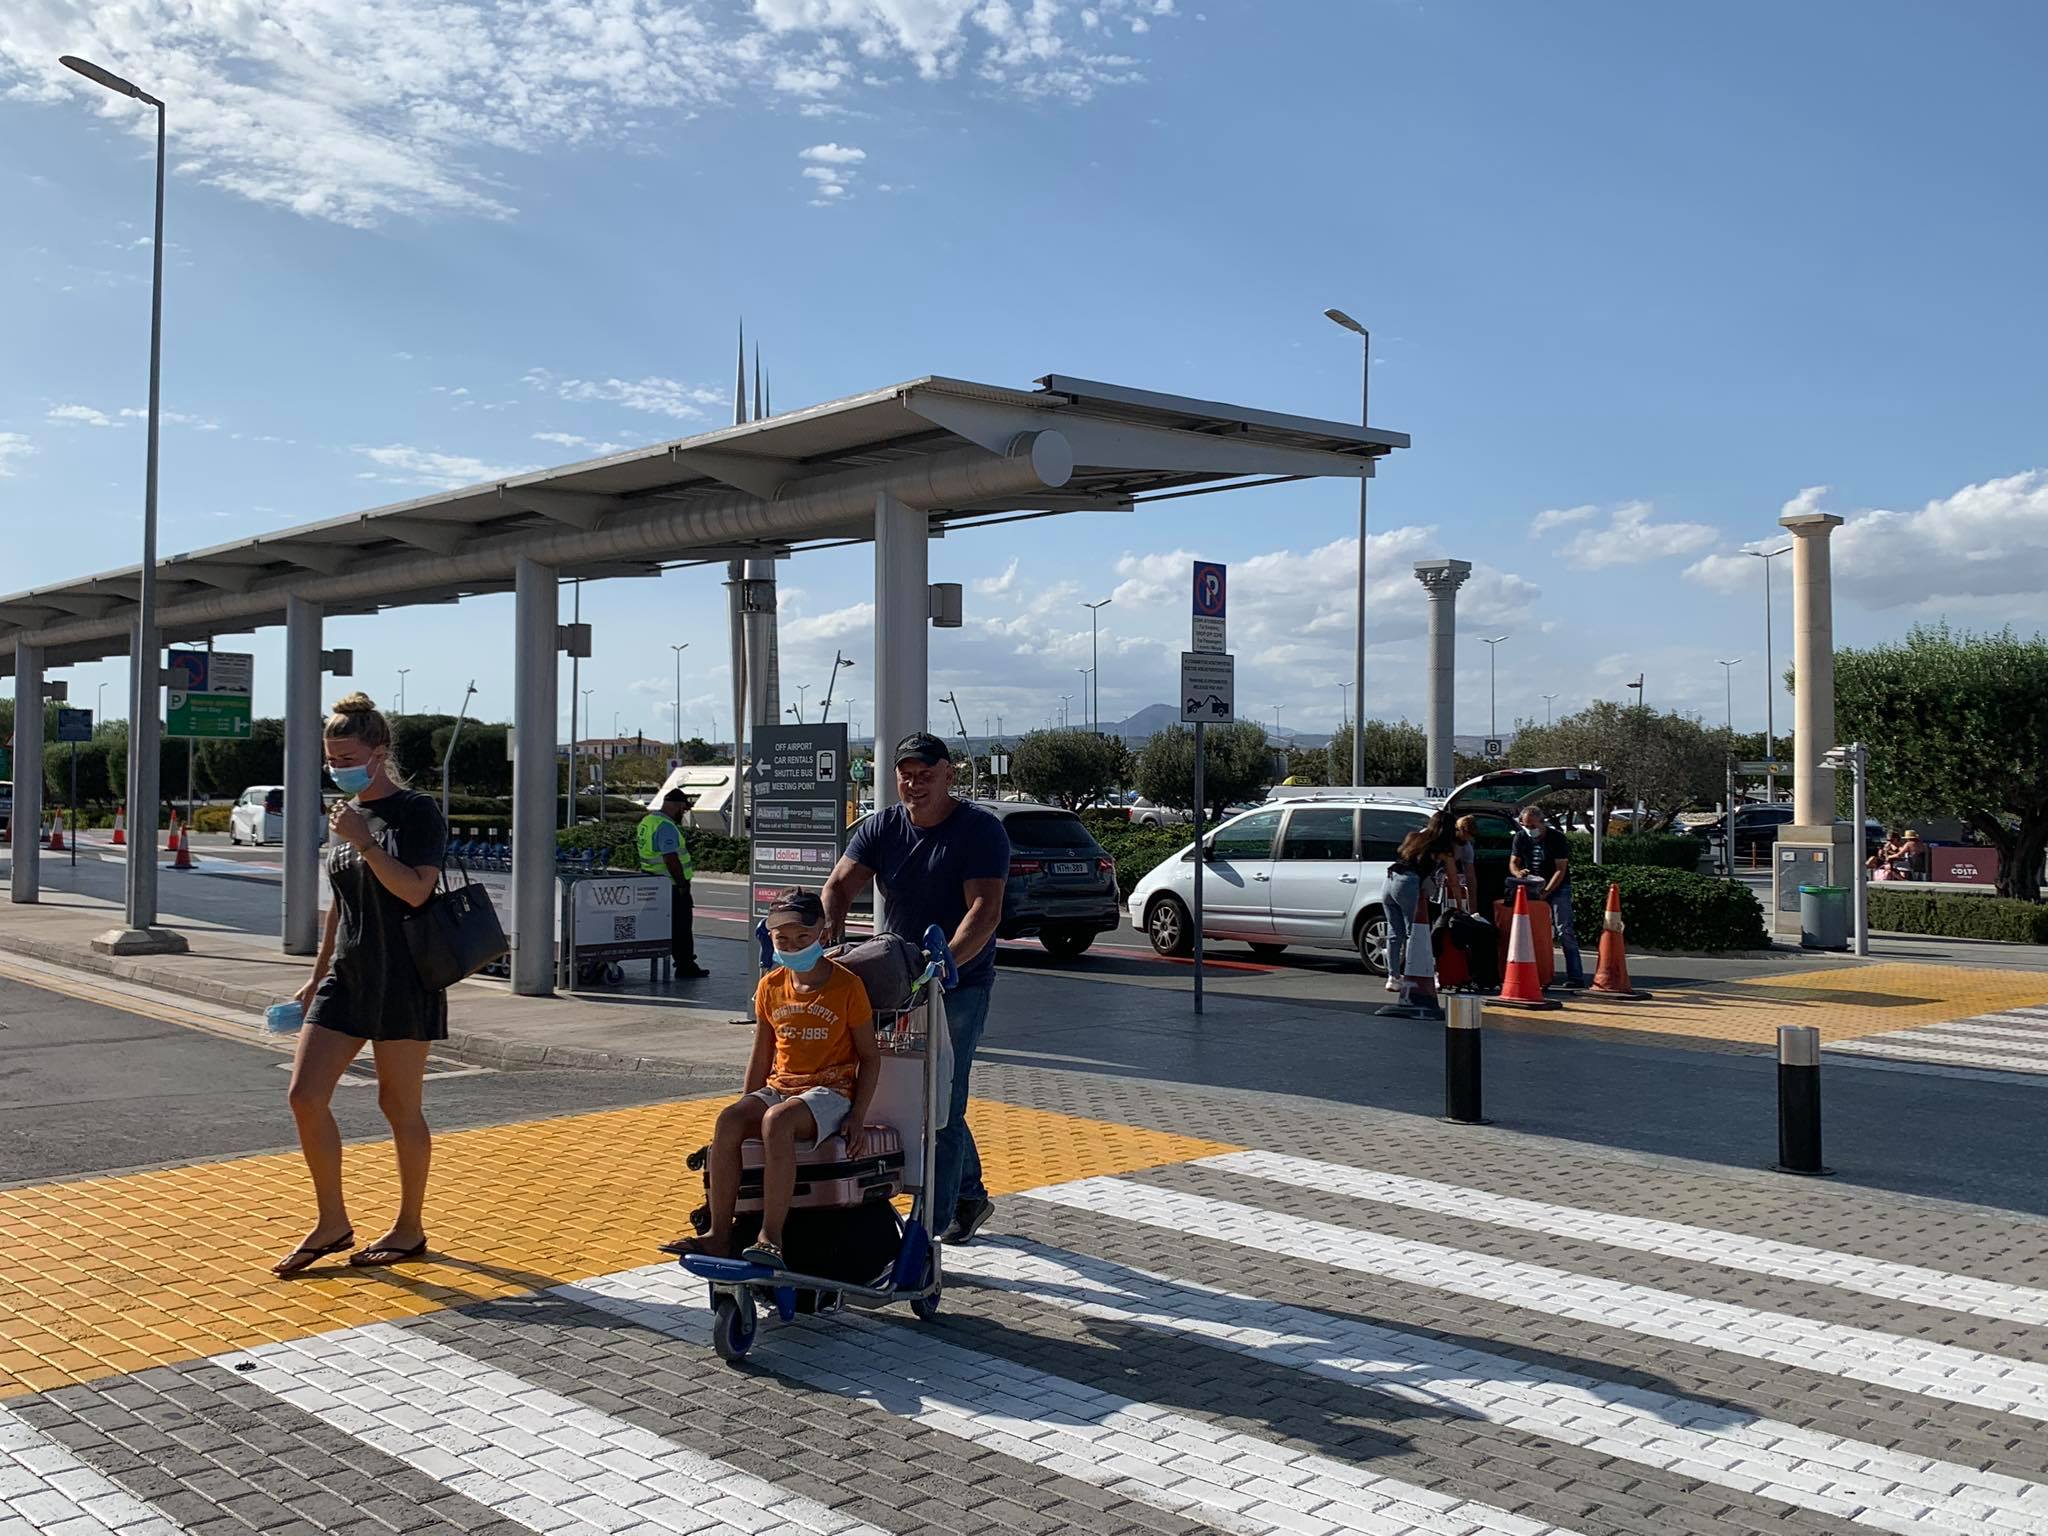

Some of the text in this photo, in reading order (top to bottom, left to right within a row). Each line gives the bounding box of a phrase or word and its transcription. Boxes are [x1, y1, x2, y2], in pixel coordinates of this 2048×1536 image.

[171, 695, 181, 707] P
[775, 742, 812, 751] OFF AIRPORT
[1490, 743, 1497, 752] B
[774, 755, 814, 764] CAR RENTALS
[774, 769, 814, 777] SHUTTLE BUS
[772, 782, 816, 790] MEETING POINT
[1426, 787, 1449, 798] TAXI
[1951, 868, 1978, 876] COSTA
[807, 1002, 840, 1025] SUPPLY
